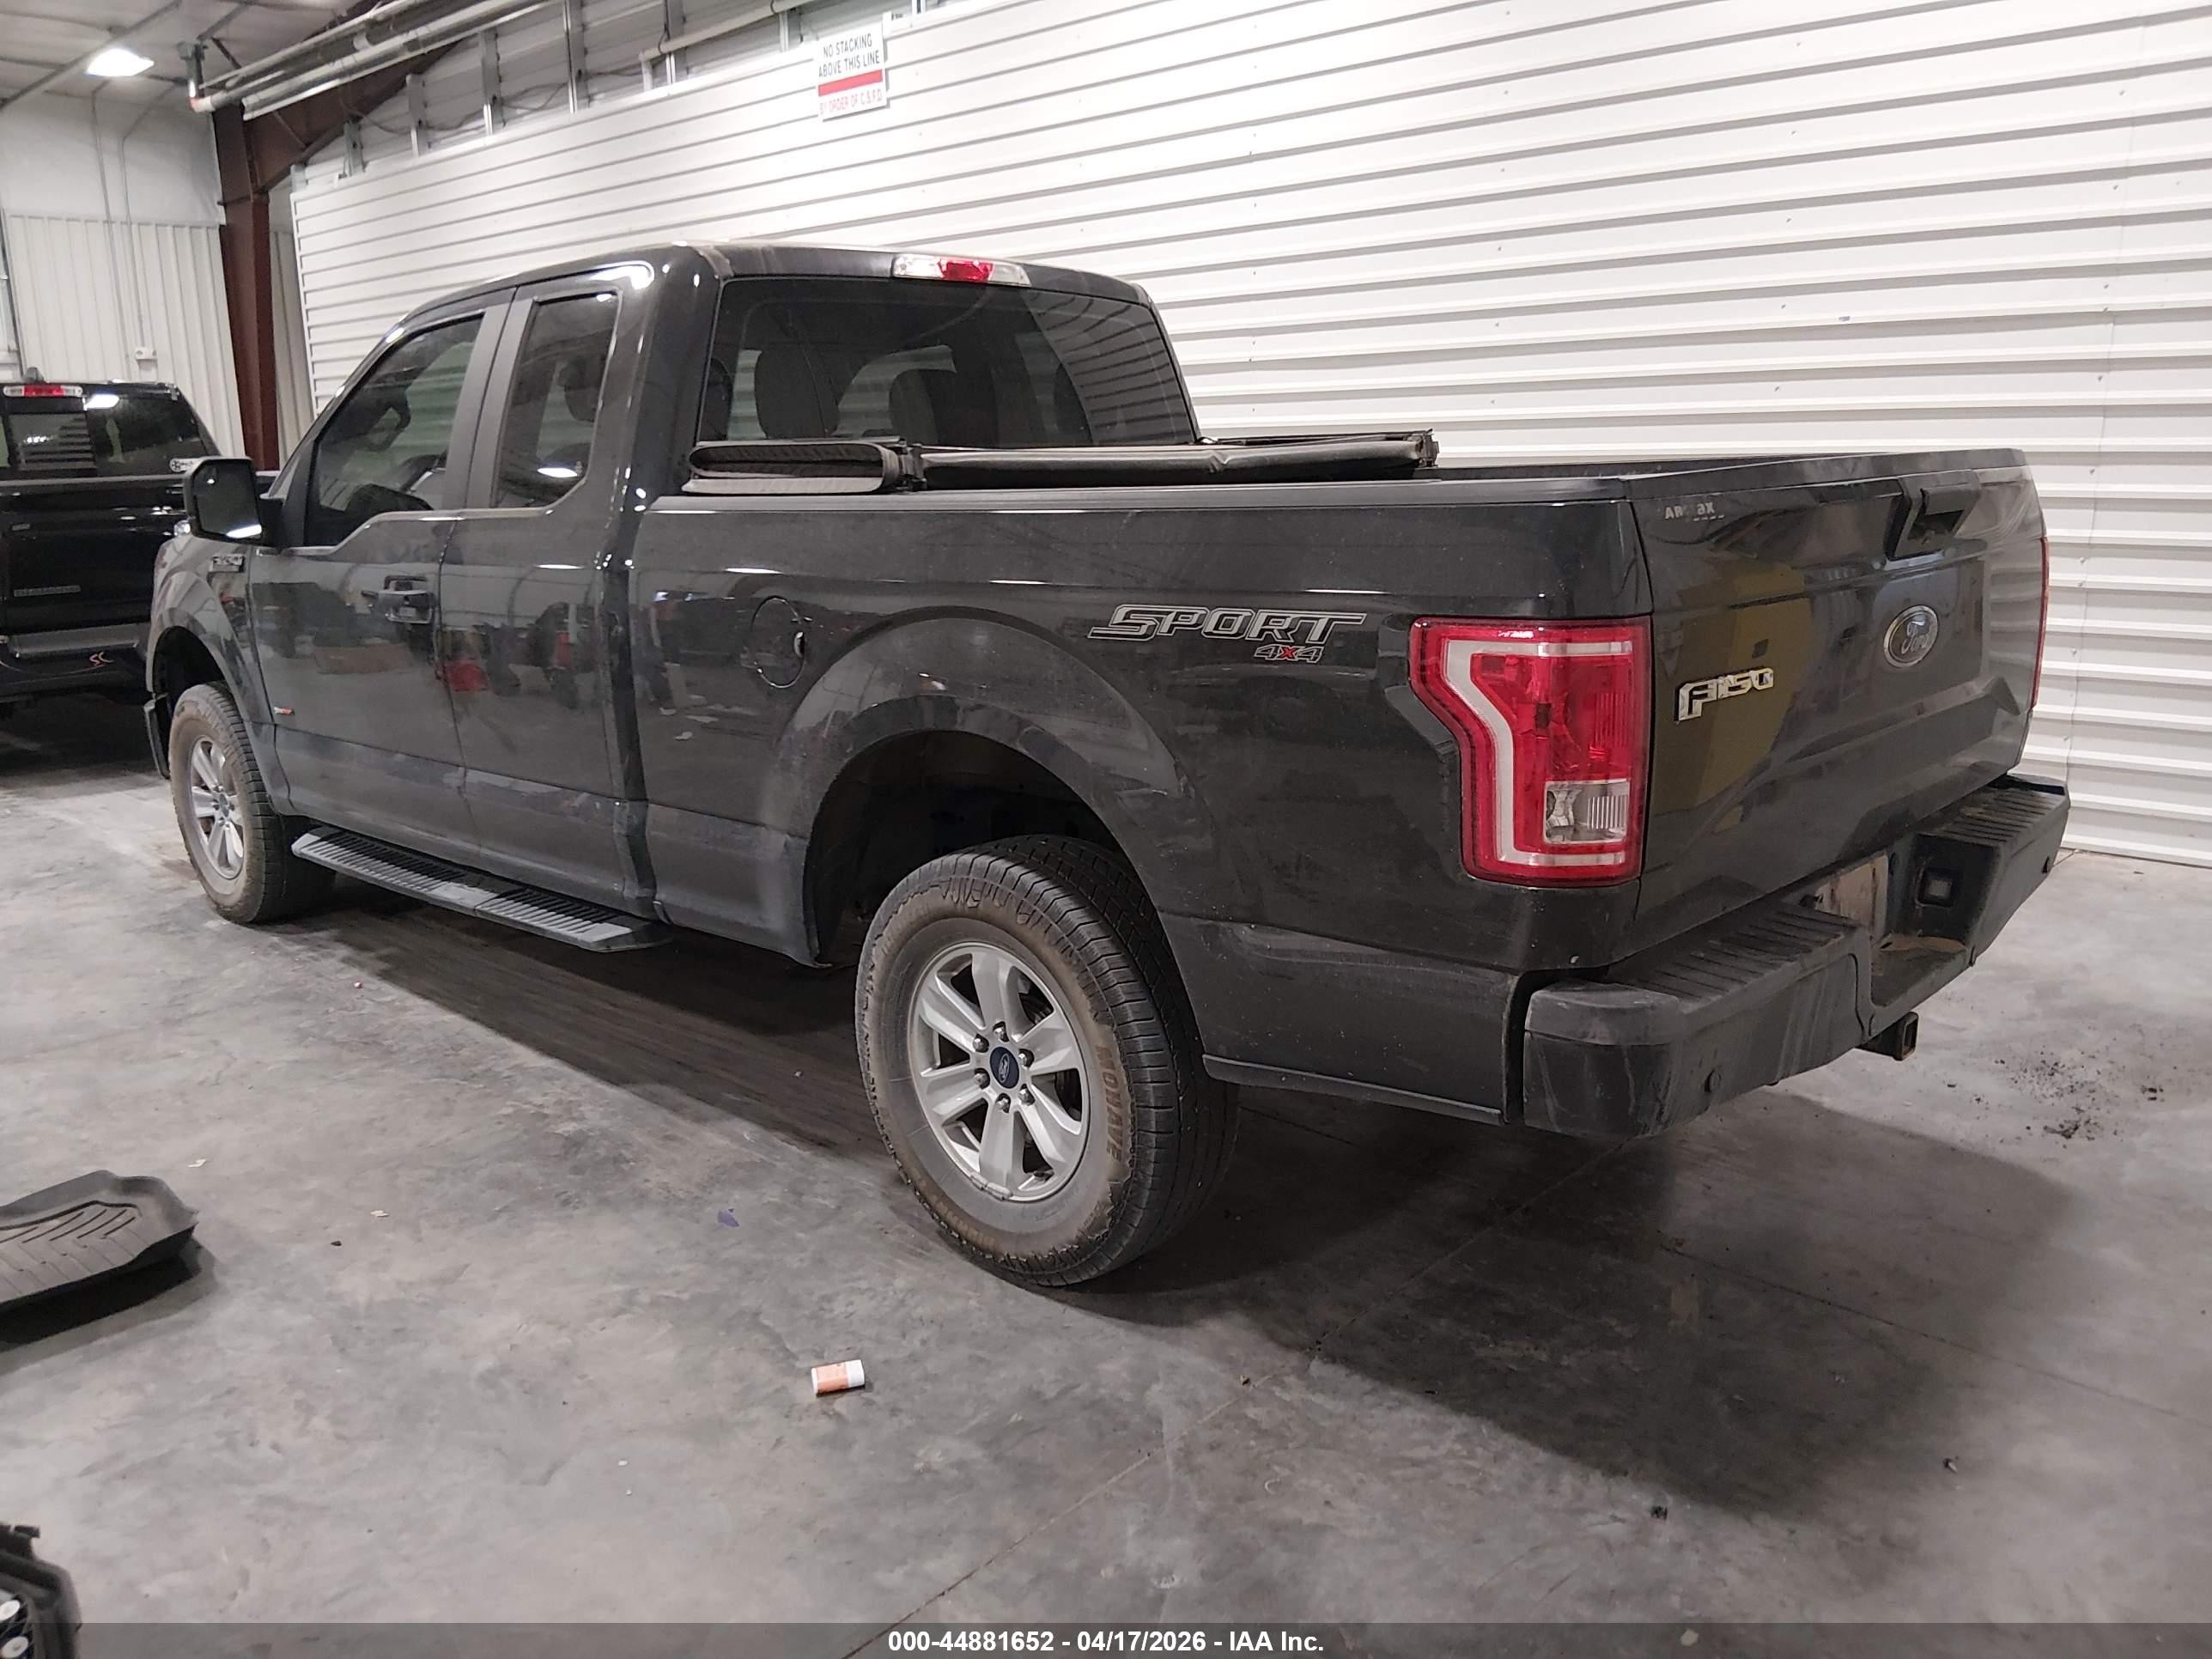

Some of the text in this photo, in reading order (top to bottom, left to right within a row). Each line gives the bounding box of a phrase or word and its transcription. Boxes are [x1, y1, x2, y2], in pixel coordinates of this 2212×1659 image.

[823, 33, 872, 58] NO STACKING
[818, 49, 880, 78] ABOVE THIS LINE
[1087, 604, 1367, 644] SPORT
